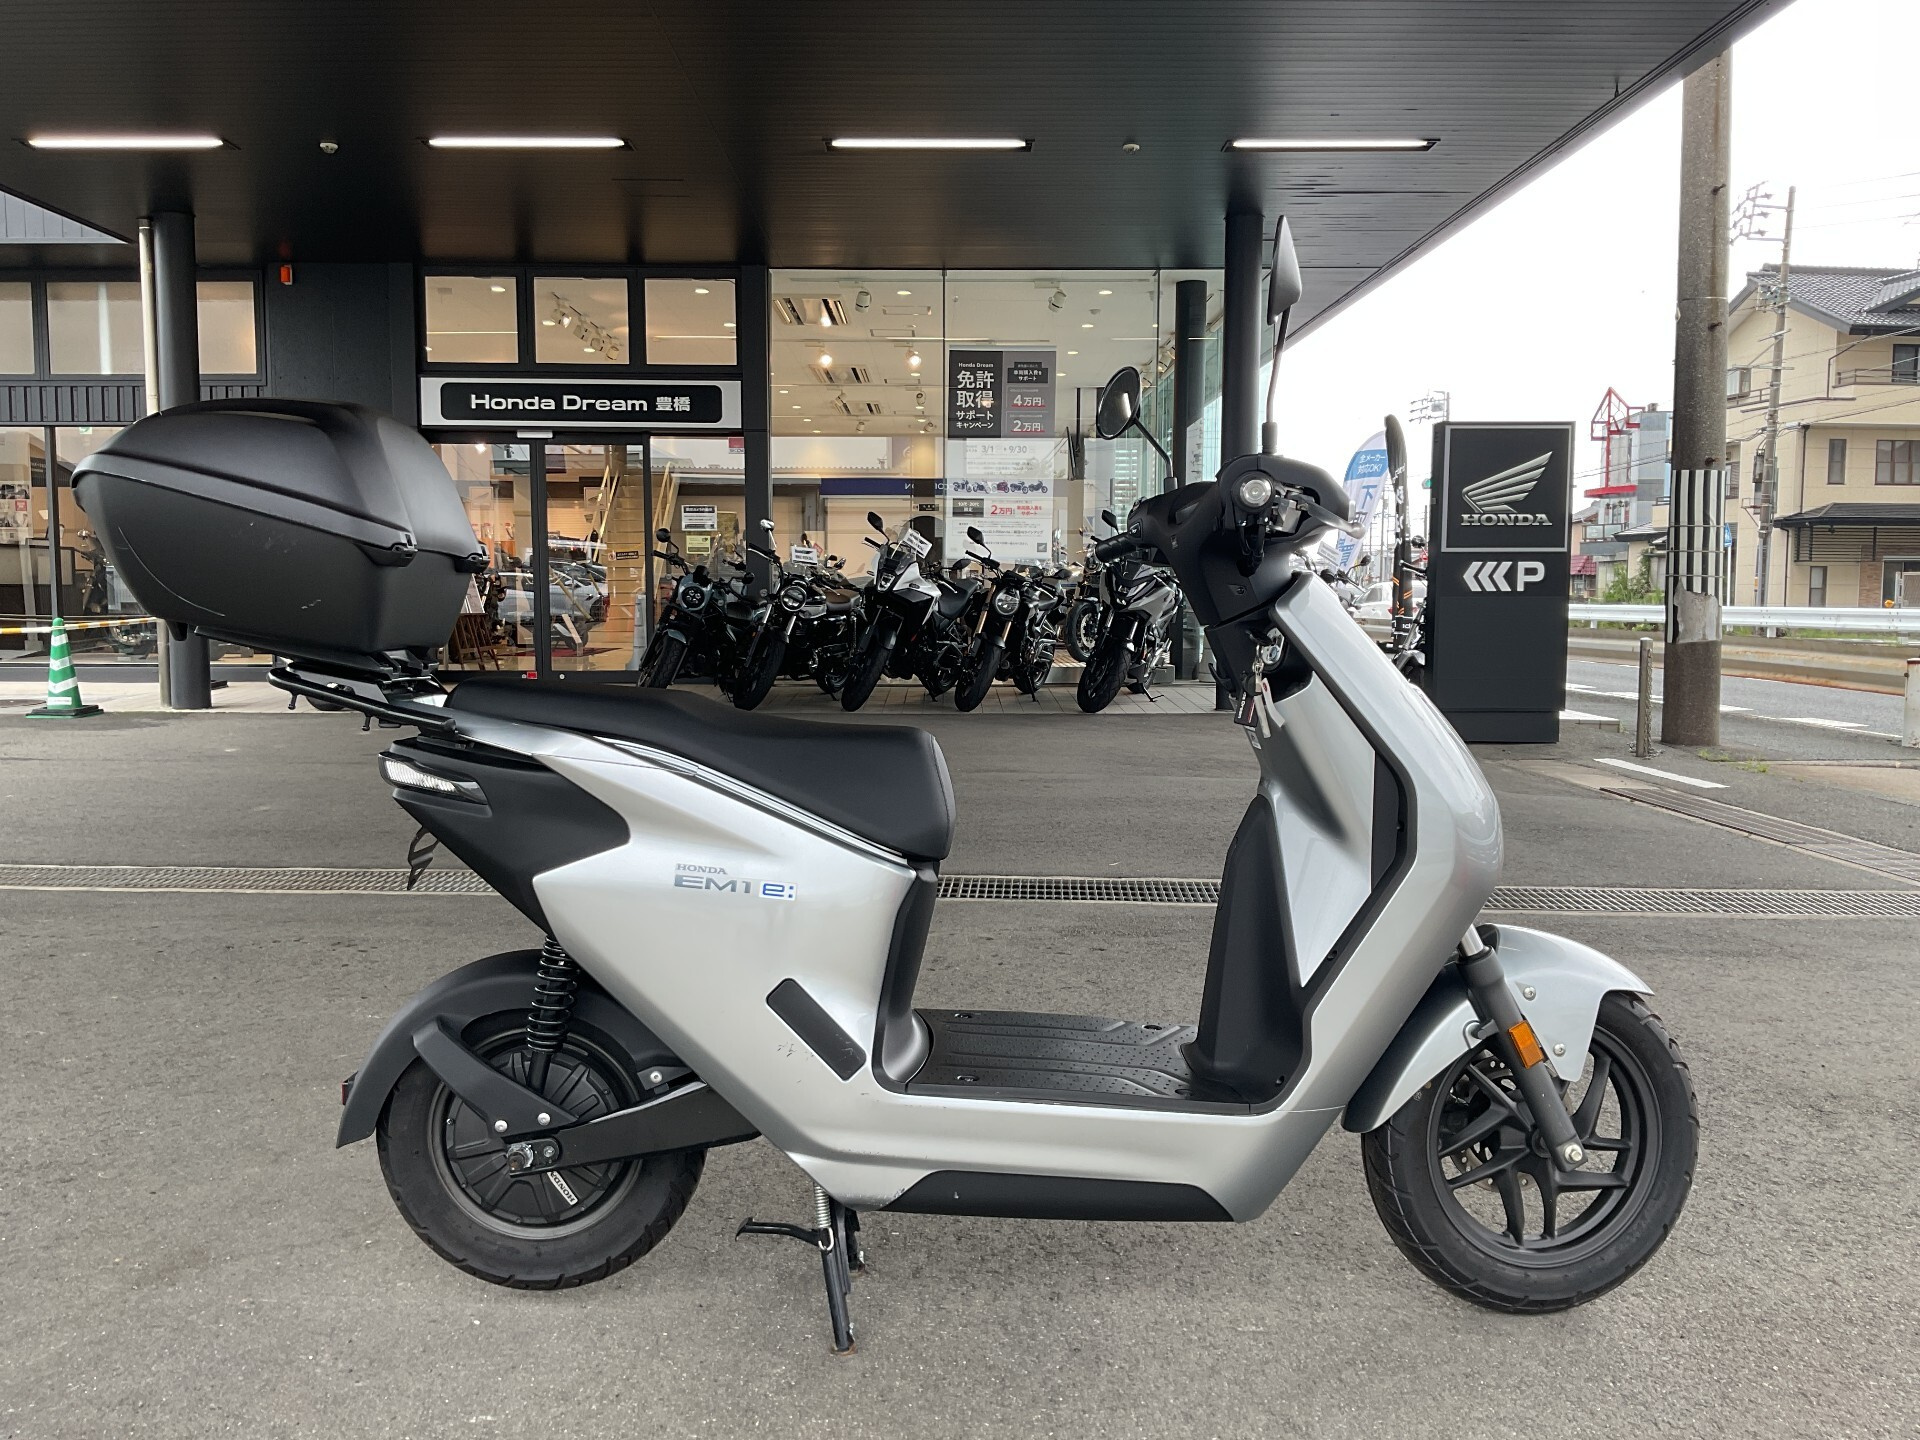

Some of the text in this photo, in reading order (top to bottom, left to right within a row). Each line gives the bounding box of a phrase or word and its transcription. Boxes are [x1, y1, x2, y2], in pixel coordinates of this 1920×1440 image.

[957, 370, 995, 389] 免許
[470, 393, 691, 412] Honda Dream 豊橋
[1013, 394, 1042, 406] 4万円
[956, 410, 994, 420] サポート
[956, 421, 994, 429] キャンペーン
[1013, 419, 1041, 432] 2万円
[981, 445, 994, 454] 3/1
[1008, 445, 1028, 454] 9/30
[990, 504, 1013, 515] 2万円
[1460, 513, 1553, 526] HONDA
[1516, 561, 1545, 592] P
[675, 862, 729, 875] HONDA
[674, 874, 752, 894] EM1
